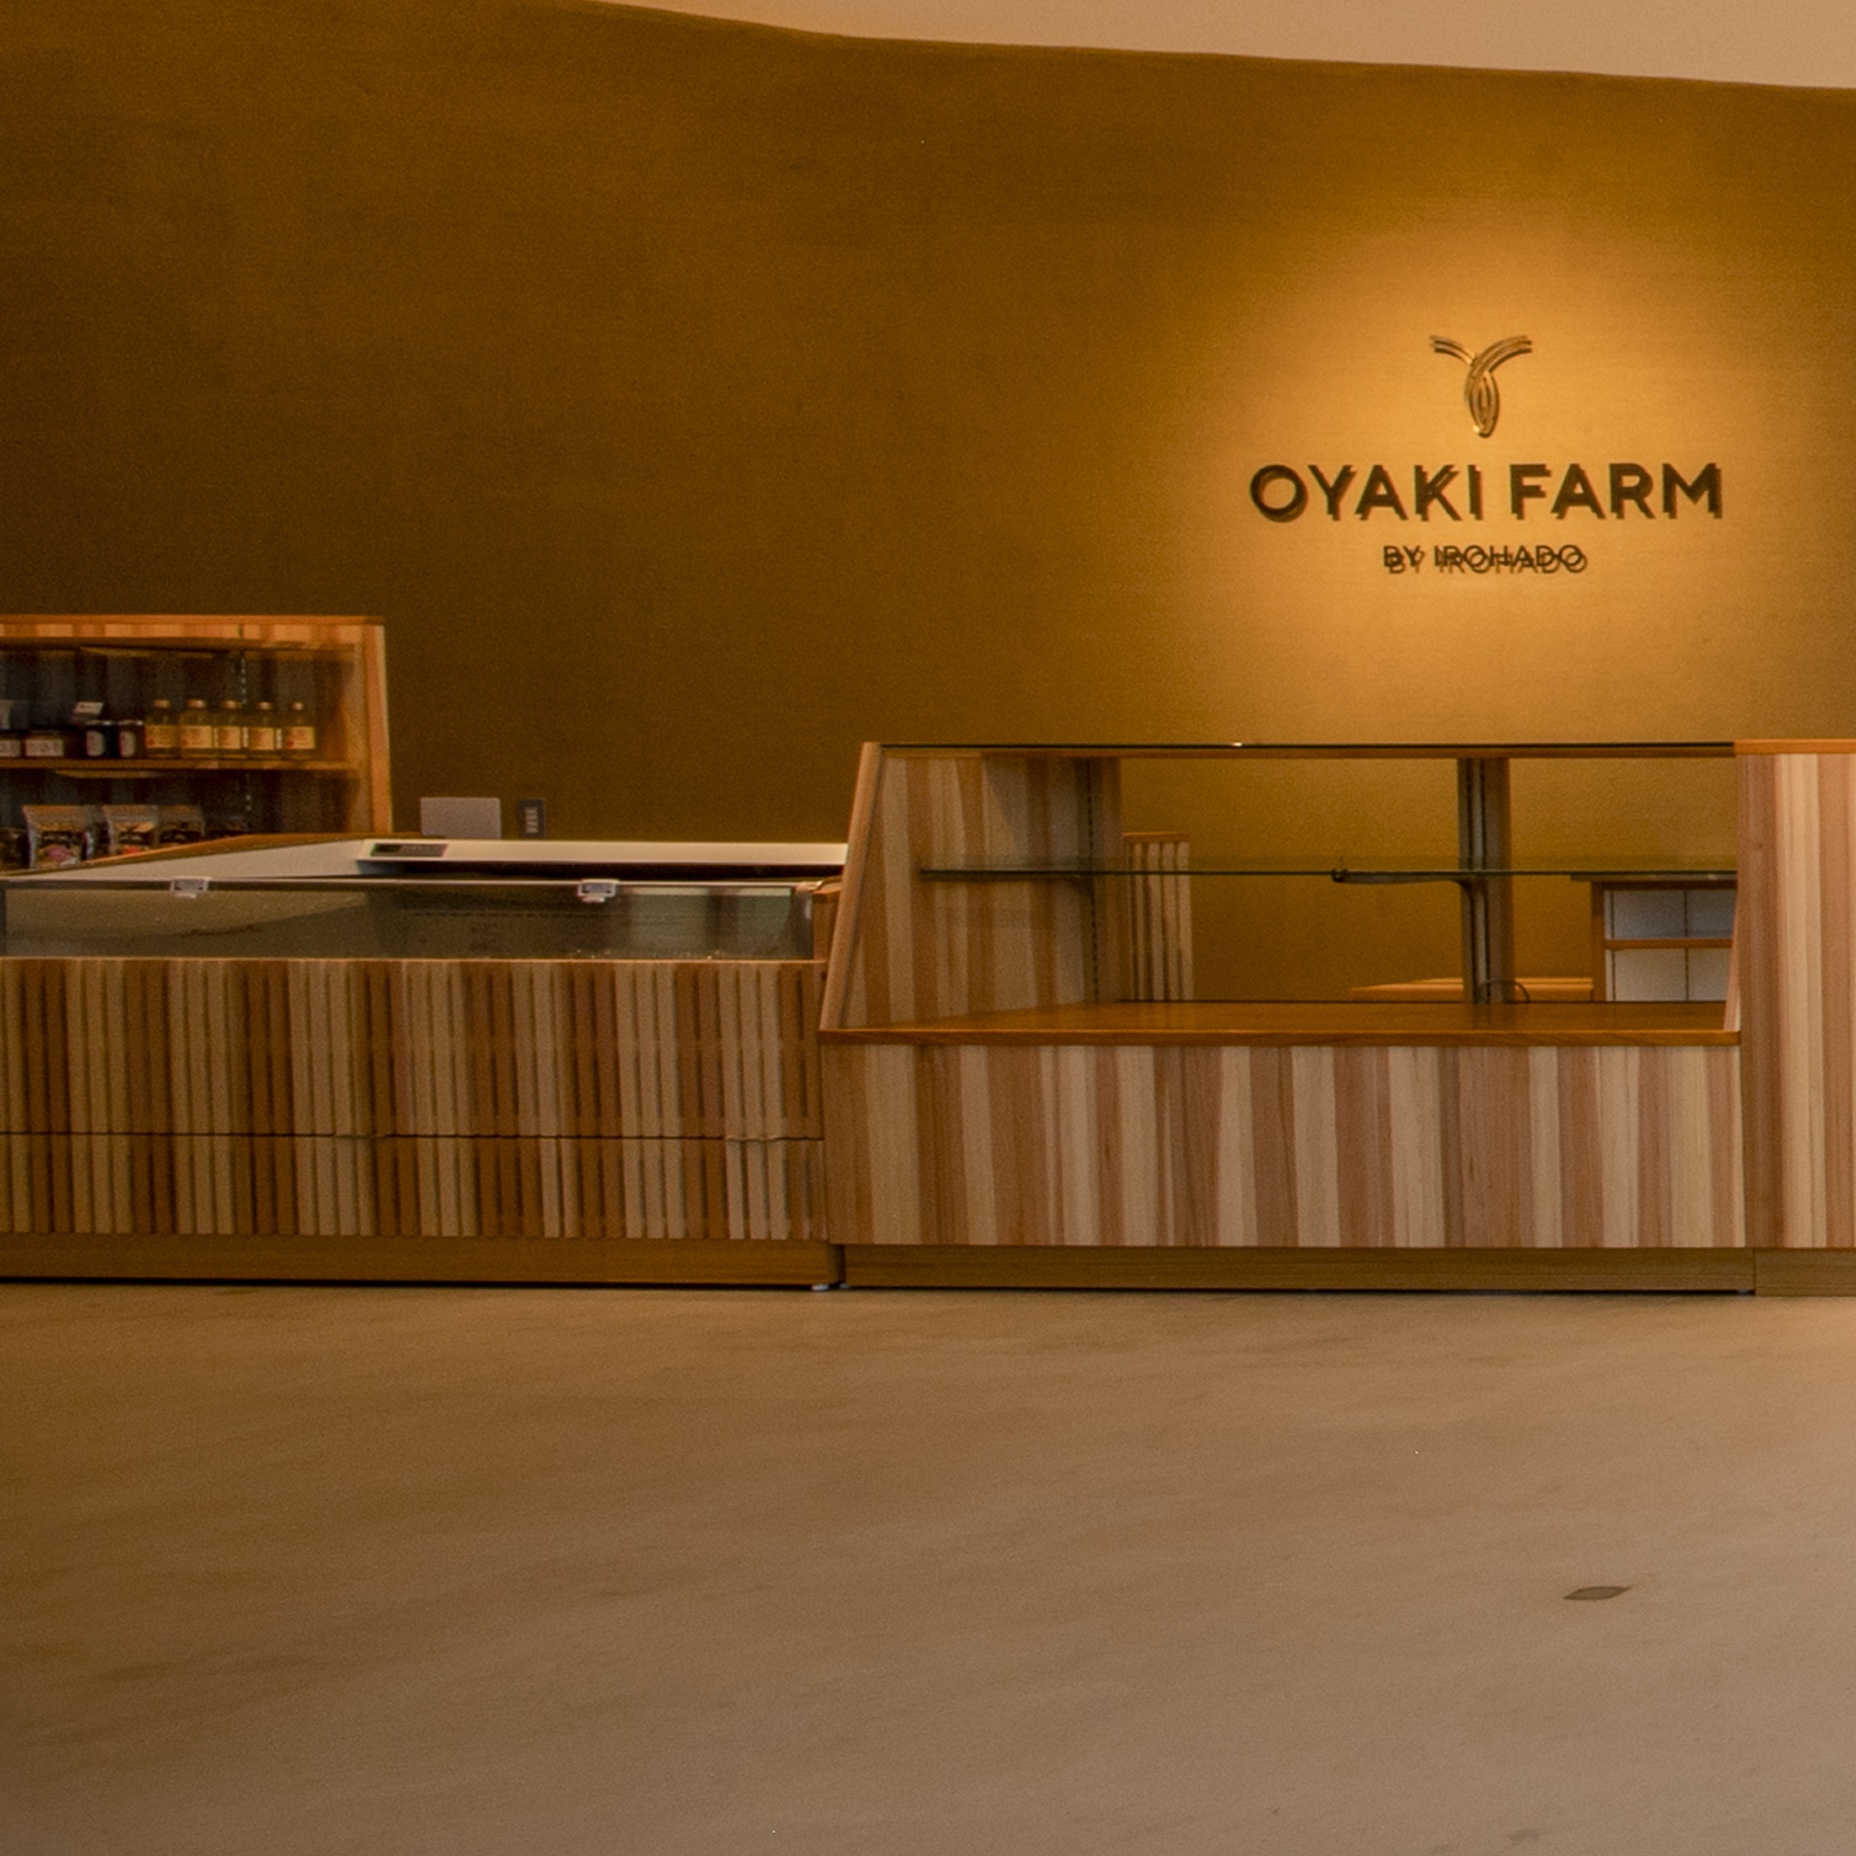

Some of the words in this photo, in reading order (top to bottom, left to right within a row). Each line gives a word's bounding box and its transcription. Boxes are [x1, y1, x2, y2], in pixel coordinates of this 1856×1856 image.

[1249, 463, 1482, 522] OYAKI
[1509, 462, 1721, 519] FARM
[1383, 545, 1423, 571] BY
[1434, 544, 1586, 571] IROHADO
